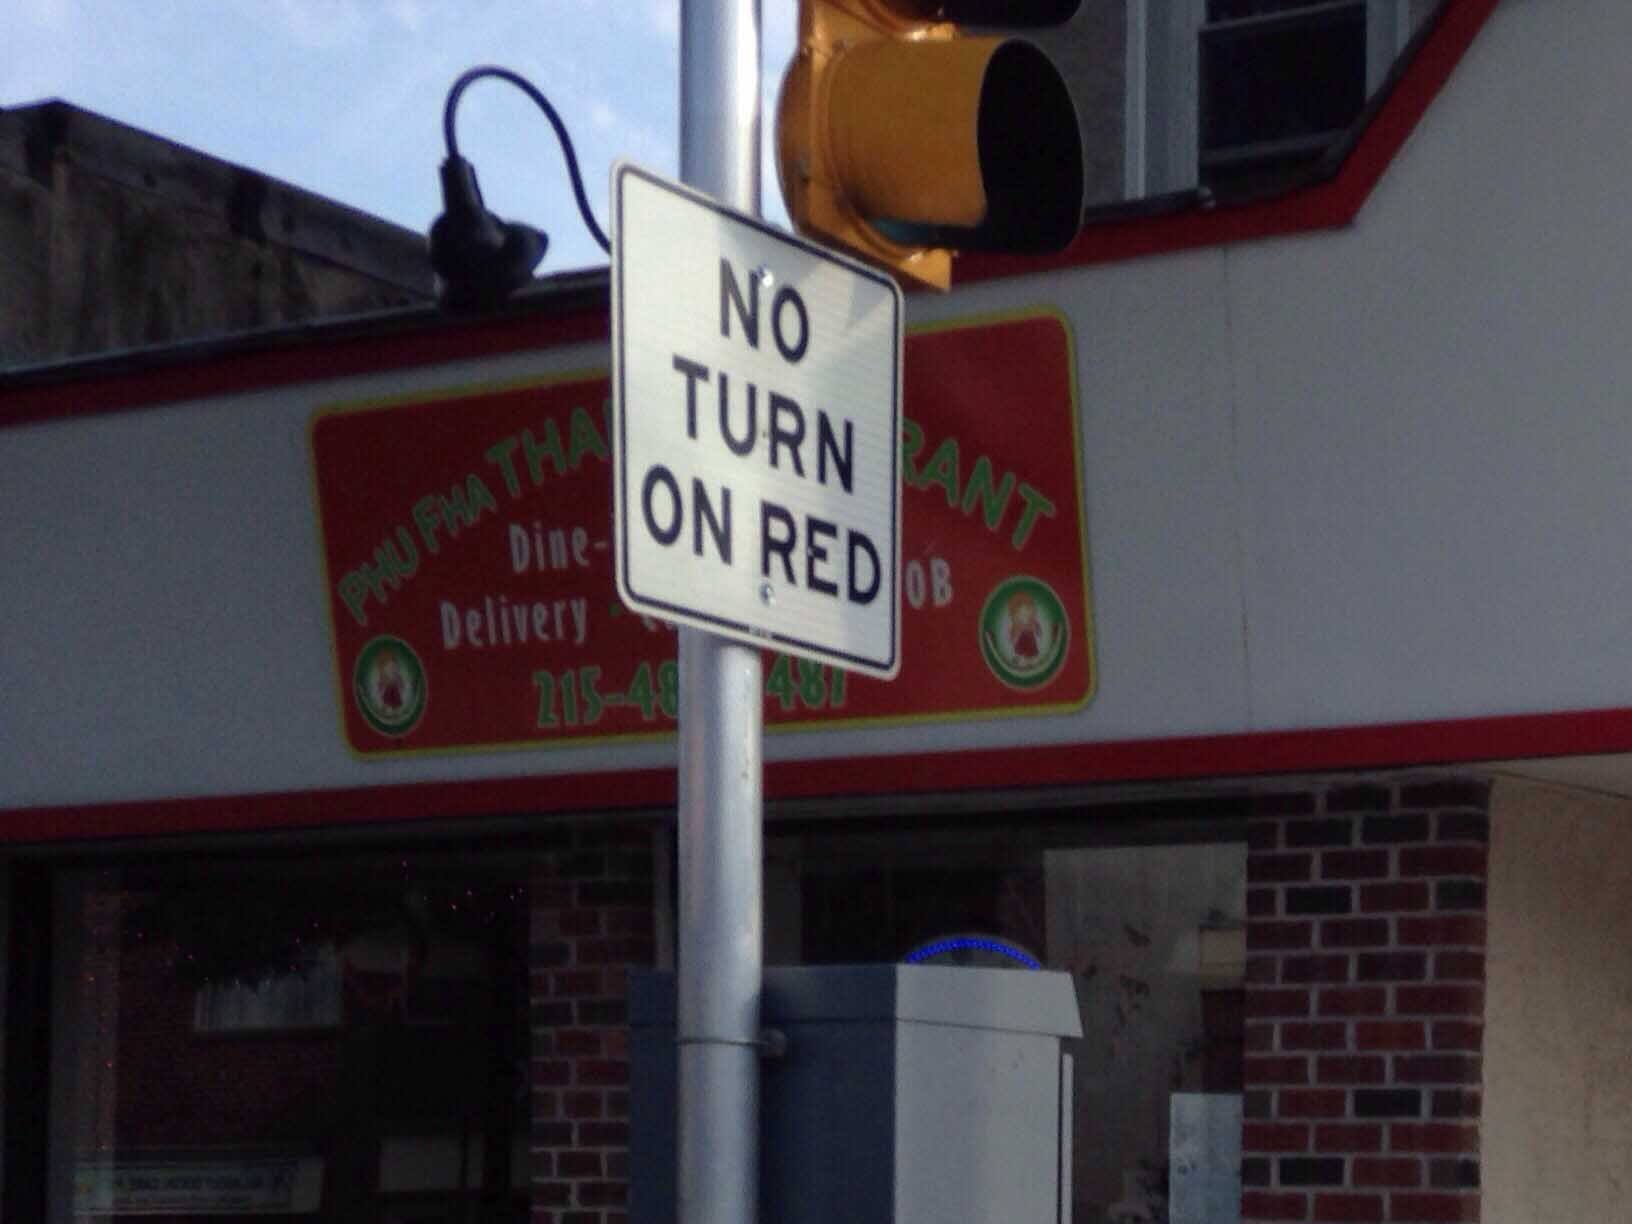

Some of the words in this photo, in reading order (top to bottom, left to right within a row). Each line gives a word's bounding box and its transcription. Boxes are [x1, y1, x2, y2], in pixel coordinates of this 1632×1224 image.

[720, 258, 810, 363] NO
[673, 355, 853, 495] TURN
[337, 523, 419, 626] PHU
[412, 471, 497, 554] FHA
[507, 520, 608, 574] Dine-
[641, 464, 733, 566] ON
[759, 498, 881, 605] RED
[440, 595, 587, 649] Delivery
